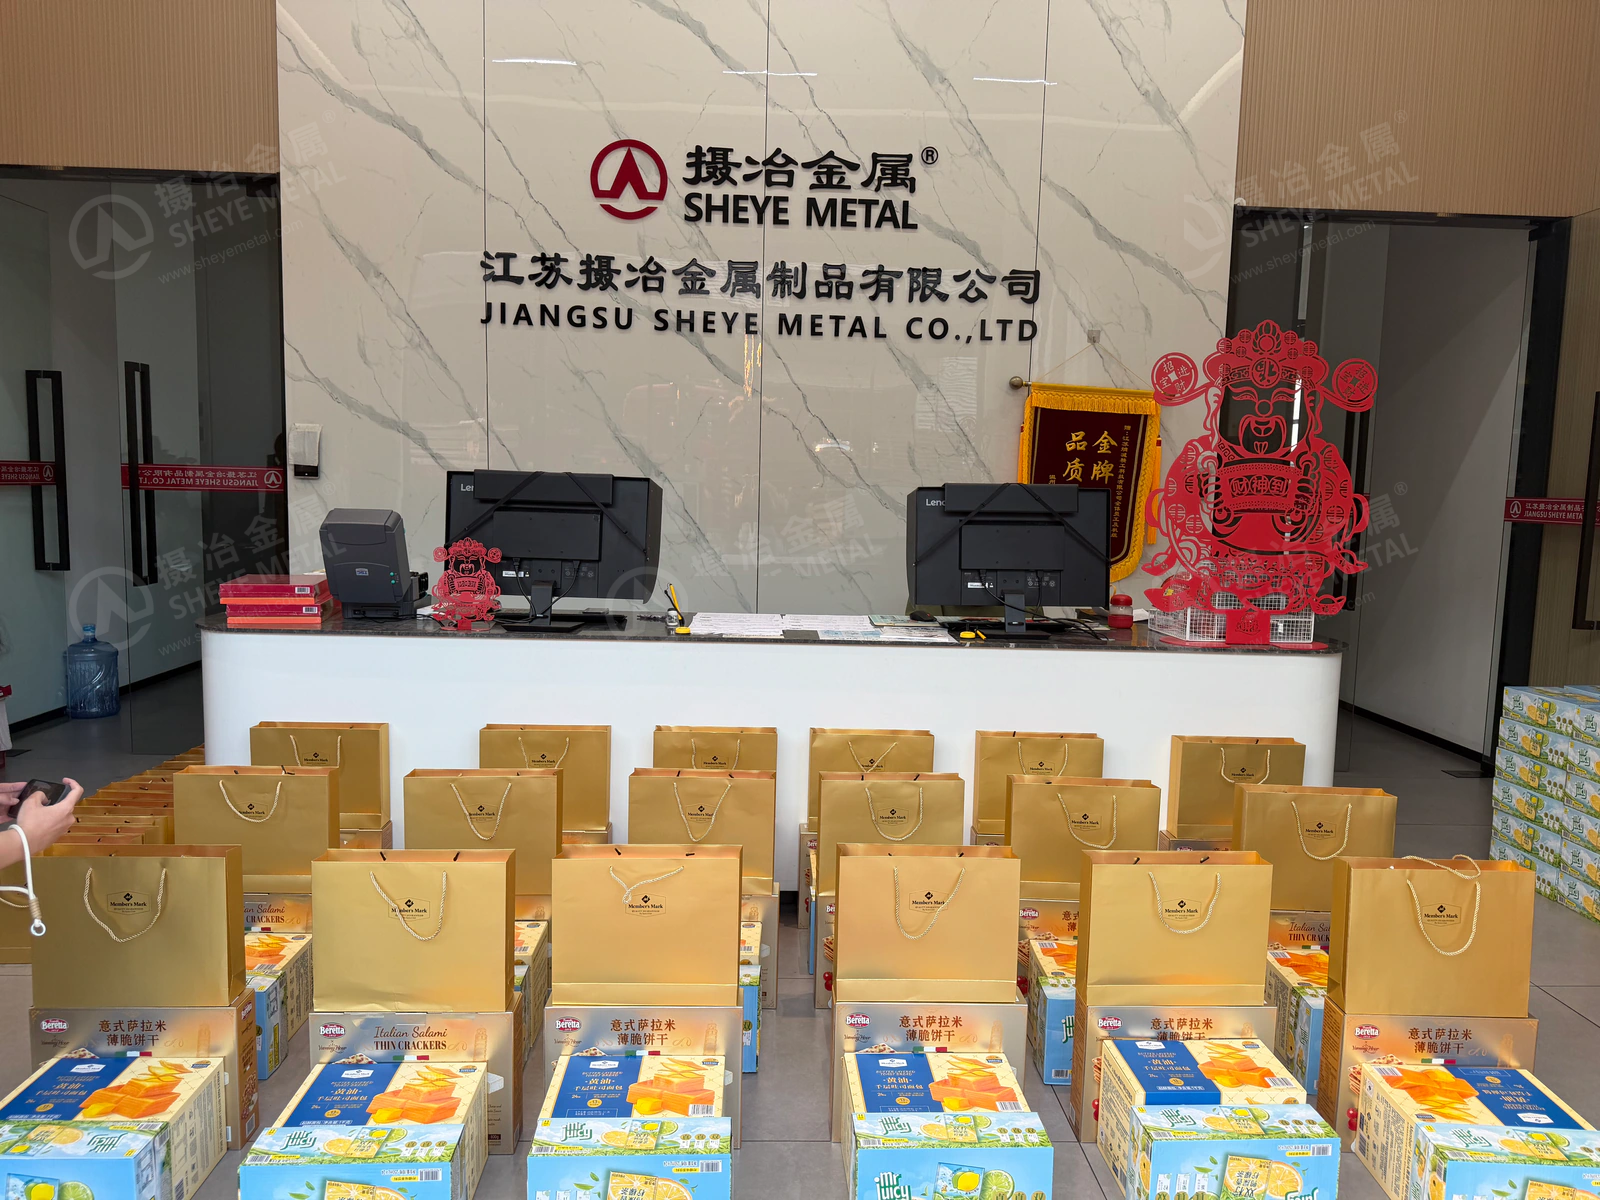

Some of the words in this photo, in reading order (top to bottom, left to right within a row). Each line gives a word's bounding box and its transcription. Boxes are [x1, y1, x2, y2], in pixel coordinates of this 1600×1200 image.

[683, 145, 917, 194] 摄冶金属
[684, 192, 789, 226] SHEYE
[805, 197, 918, 230] METAL
[479, 250, 1041, 305] 江苏摄冶金属制品有限公司
[480, 302, 634, 330] JIANGSU
[653, 309, 759, 336] SHEYE
[778, 312, 887, 339] METAL
[906, 316, 1038, 344] CO.,LTD
[1523, 510, 1548, 518] JIANGSU
[1548, 511, 1566, 519] SHEYE
[1566, 512, 1583, 520] META
[256, 904, 285, 913] Salami
[246, 915, 285, 923] CRACKERS
[1288, 921, 1315, 931] Italian
[1288, 933, 1305, 941] THIN
[41, 1020, 67, 1029] Beretta
[99, 1019, 167, 1032] 意式萨拉米
[556, 1020, 580, 1028] Beretta
[610, 1018, 676, 1032] 意式萨拉米
[846, 1016, 869, 1025] Beretta
[899, 1015, 963, 1028] 意式萨拉米
[1098, 1018, 1121, 1027] Beretta
[1150, 1017, 1214, 1030] 意式萨拉米
[320, 1026, 345, 1035] Beretta
[374, 1026, 409, 1038] Italian
[412, 1026, 447, 1038] Salami
[905, 1029, 956, 1042] 薄脆饼干
[1355, 1027, 1379, 1036] Beretta
[1408, 1027, 1472, 1041] 意式萨拉米
[106, 1034, 160, 1046] 薄脆饼干
[374, 1040, 396, 1050] THIN
[398, 1040, 447, 1050] CRACKERS
[617, 1033, 669, 1046] 薄脆饼干
[1414, 1041, 1465, 1054] 薄脆饼干
[560, 1125, 592, 1142] juicy
[878, 1119, 912, 1135] juicy
[280, 1135, 317, 1150] juicy
[879, 1171, 902, 1186] mr
